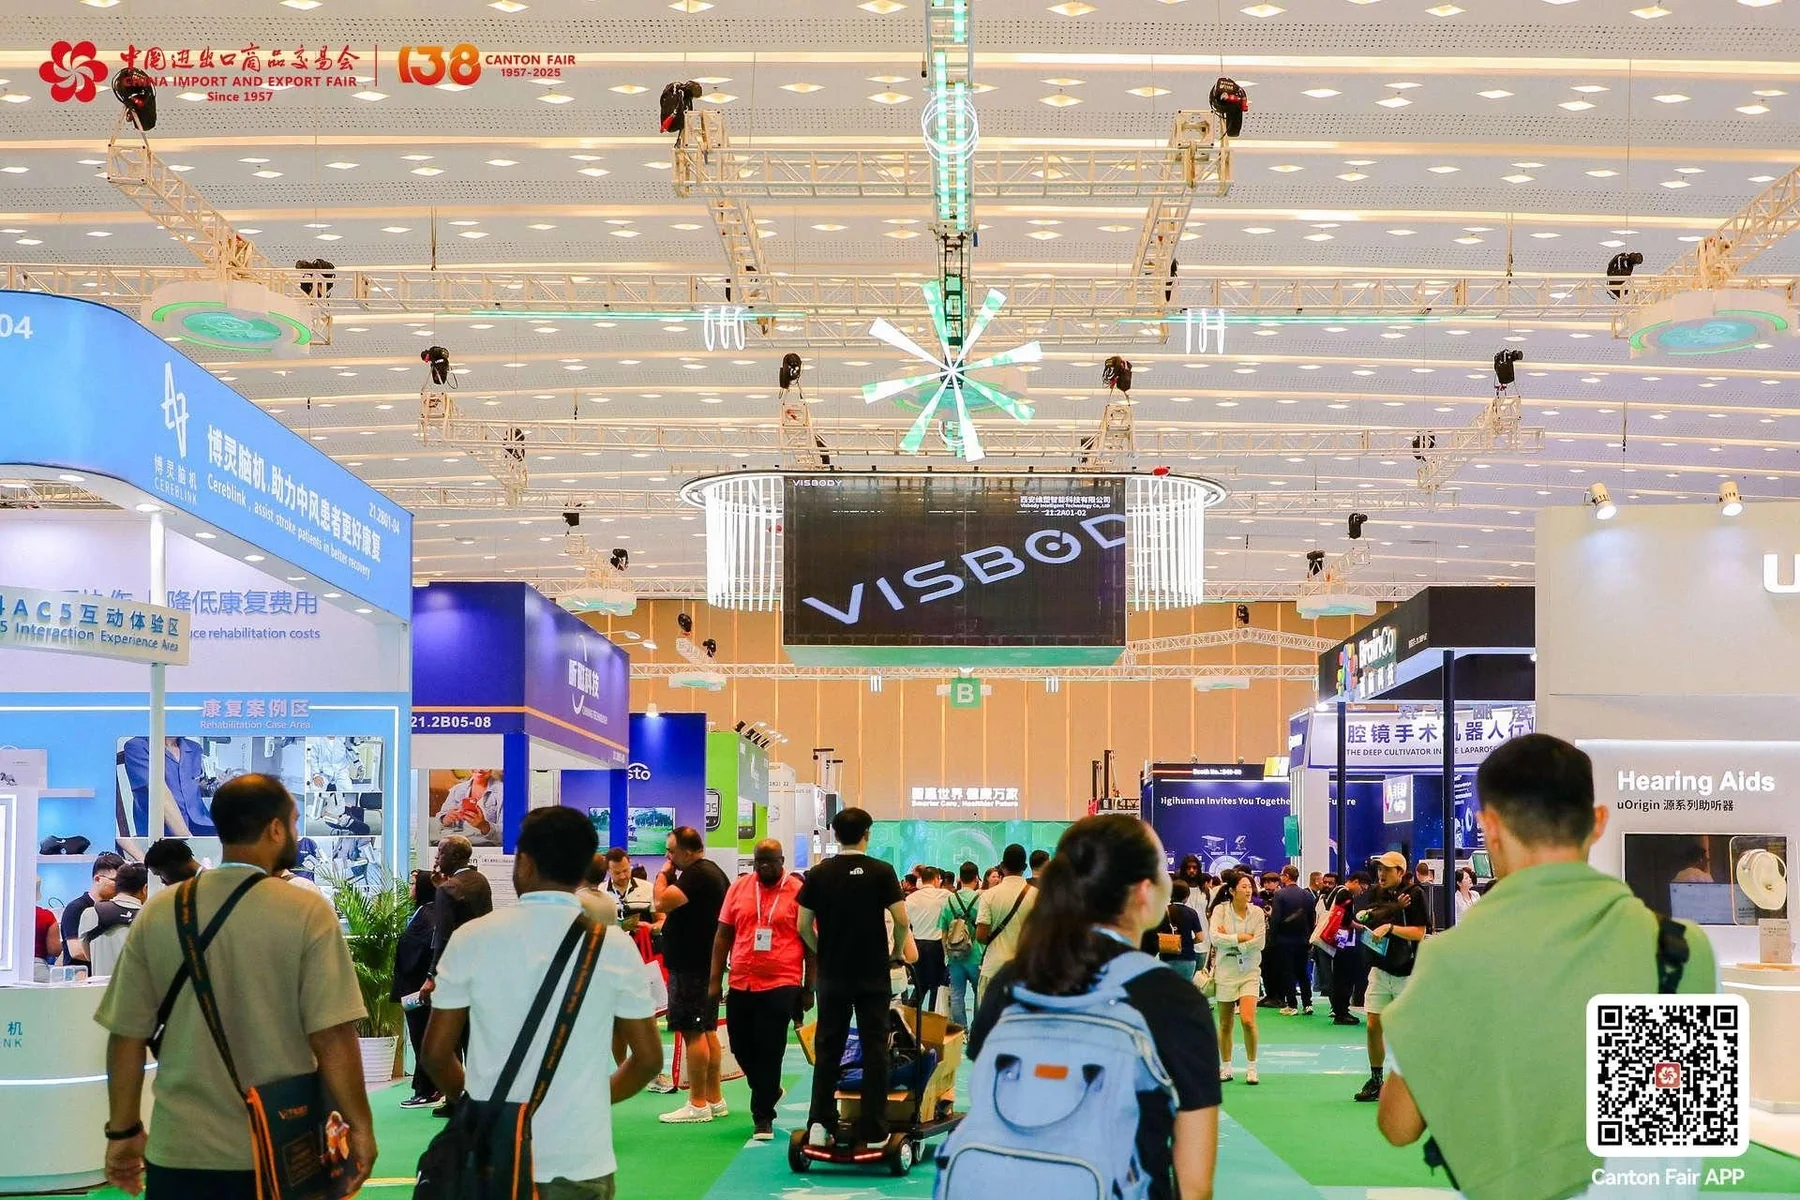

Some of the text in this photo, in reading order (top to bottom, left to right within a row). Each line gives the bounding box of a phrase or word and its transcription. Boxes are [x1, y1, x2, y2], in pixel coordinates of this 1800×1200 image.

[792, 479, 842, 487] VISBODY
[154, 477, 197, 505] CEREBLINK
[254, 501, 274, 523] assist
[275, 513, 297, 535] stroke
[298, 527, 322, 551] patients
[330, 543, 349, 566] better
[348, 556, 371, 581] recovery
[167, 590, 317, 615] 降低康复费用
[16, 622, 95, 642] Interaction
[100, 630, 158, 650] Experience
[161, 639, 179, 652] Area
[208, 627, 287, 640] rehabilitation
[290, 629, 320, 640] costs
[957, 683, 975, 703] B
[202, 699, 310, 718] 康复案例区
[201, 720, 311, 729] Rehabilitation Case Area
[411, 716, 492, 728] 21.2B05-08
[1347, 748, 1361, 757] THE
[1363, 748, 1382, 757] DEEP
[1384, 748, 1431, 757] CULTIVATOR
[1433, 747, 1442, 755] IN
[1617, 770, 1776, 796] Hearing Aids
[1207, 796, 1237, 805] Invites
[1238, 797, 1254, 805] You
[1255, 797, 1291, 807] Togethe
[1617, 799, 1734, 812] uOrigin 源系列助听器
[7, 1021, 23, 1036] 机
